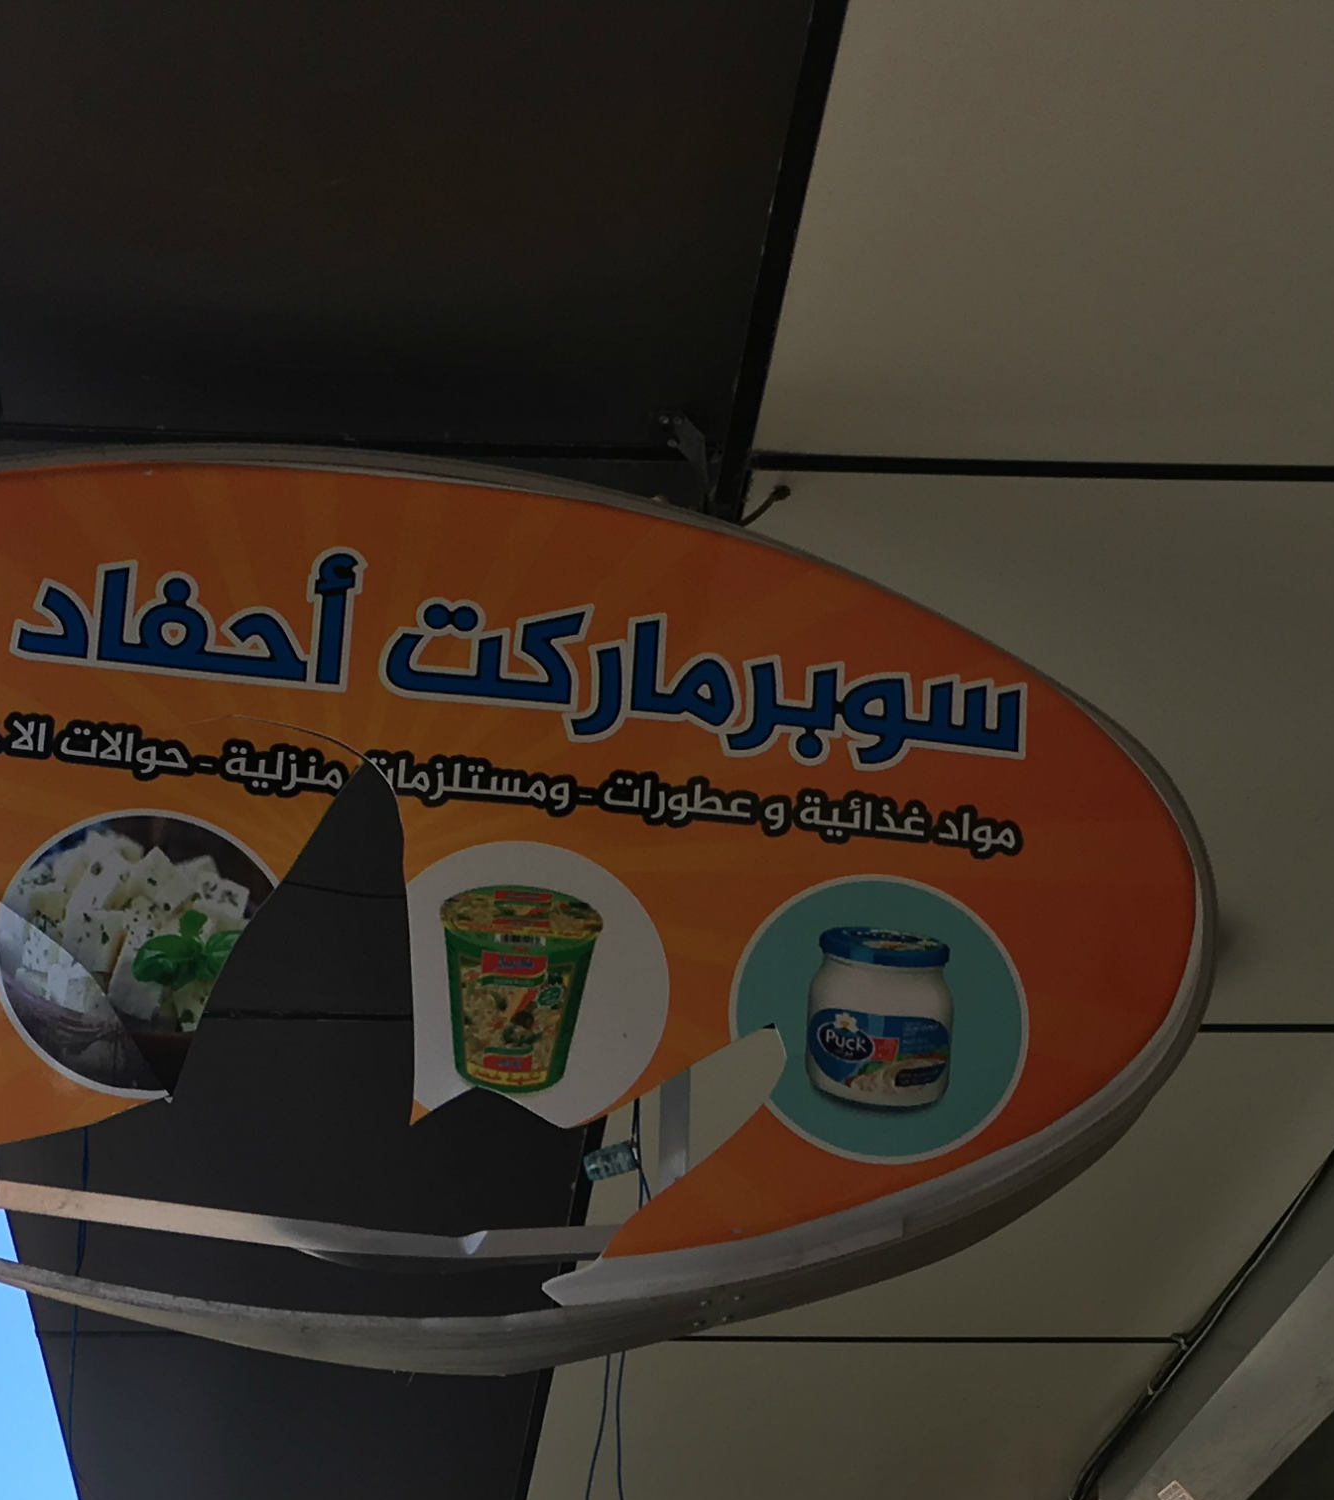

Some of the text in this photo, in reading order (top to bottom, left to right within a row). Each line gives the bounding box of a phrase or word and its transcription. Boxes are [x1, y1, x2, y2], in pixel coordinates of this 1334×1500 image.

[12, 547, 364, 691] أحفاد
[381, 600, 1025, 768] سوبرماركت
[59, 726, 188, 773] حوالات
[224, 744, 344, 791] منزلية
[602, 776, 752, 822] عطورات
[799, 794, 926, 838] غذائية
[937, 813, 1017, 853] مواد
